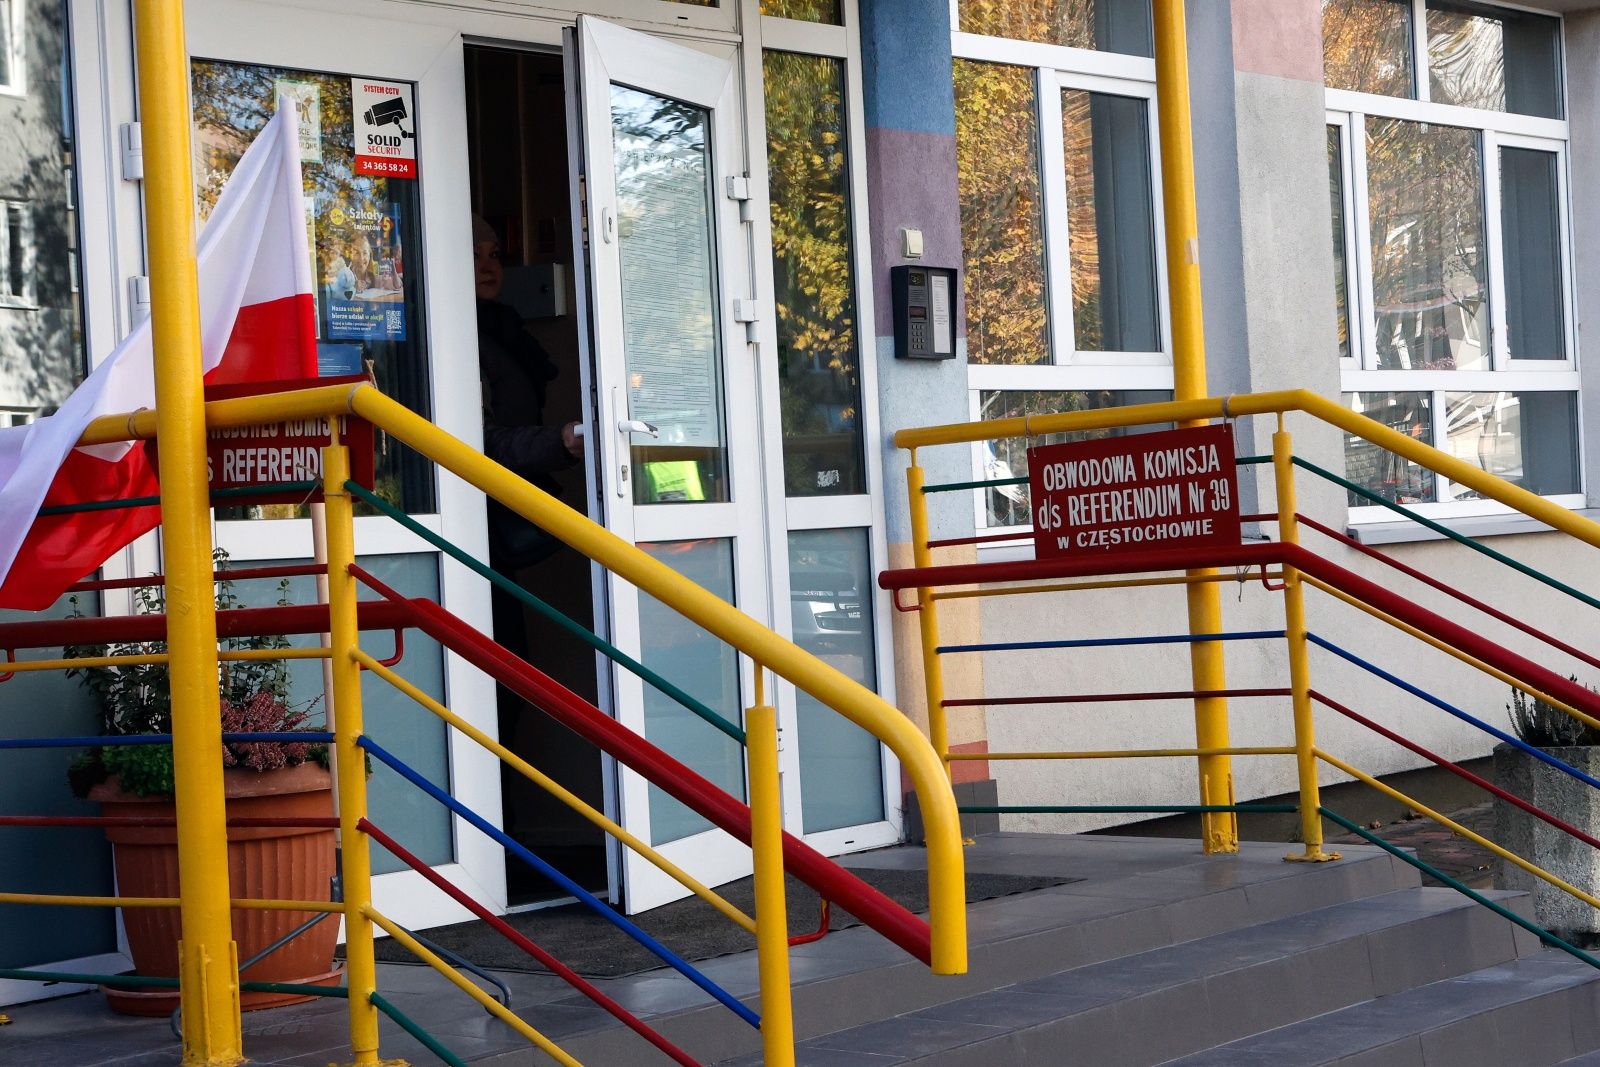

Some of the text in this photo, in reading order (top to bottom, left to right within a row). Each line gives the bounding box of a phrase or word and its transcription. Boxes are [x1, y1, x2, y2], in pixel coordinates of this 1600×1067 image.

[363, 84, 400, 96] SYSTEM CCTV
[367, 133, 401, 147] SOLID
[367, 145, 402, 155] SECURITY
[363, 161, 408, 173] 34 365 58 24
[349, 207, 383, 223] Szkoły
[223, 447, 325, 482] REFEREND
[1043, 444, 1221, 492] OBWODOWA KOMISJA
[1068, 483, 1182, 527] REFERENDUM
[1188, 481, 1206, 514] Nr
[1209, 477, 1230, 512] 39
[1076, 518, 1213, 550] CZĘSTOCHOWIE
